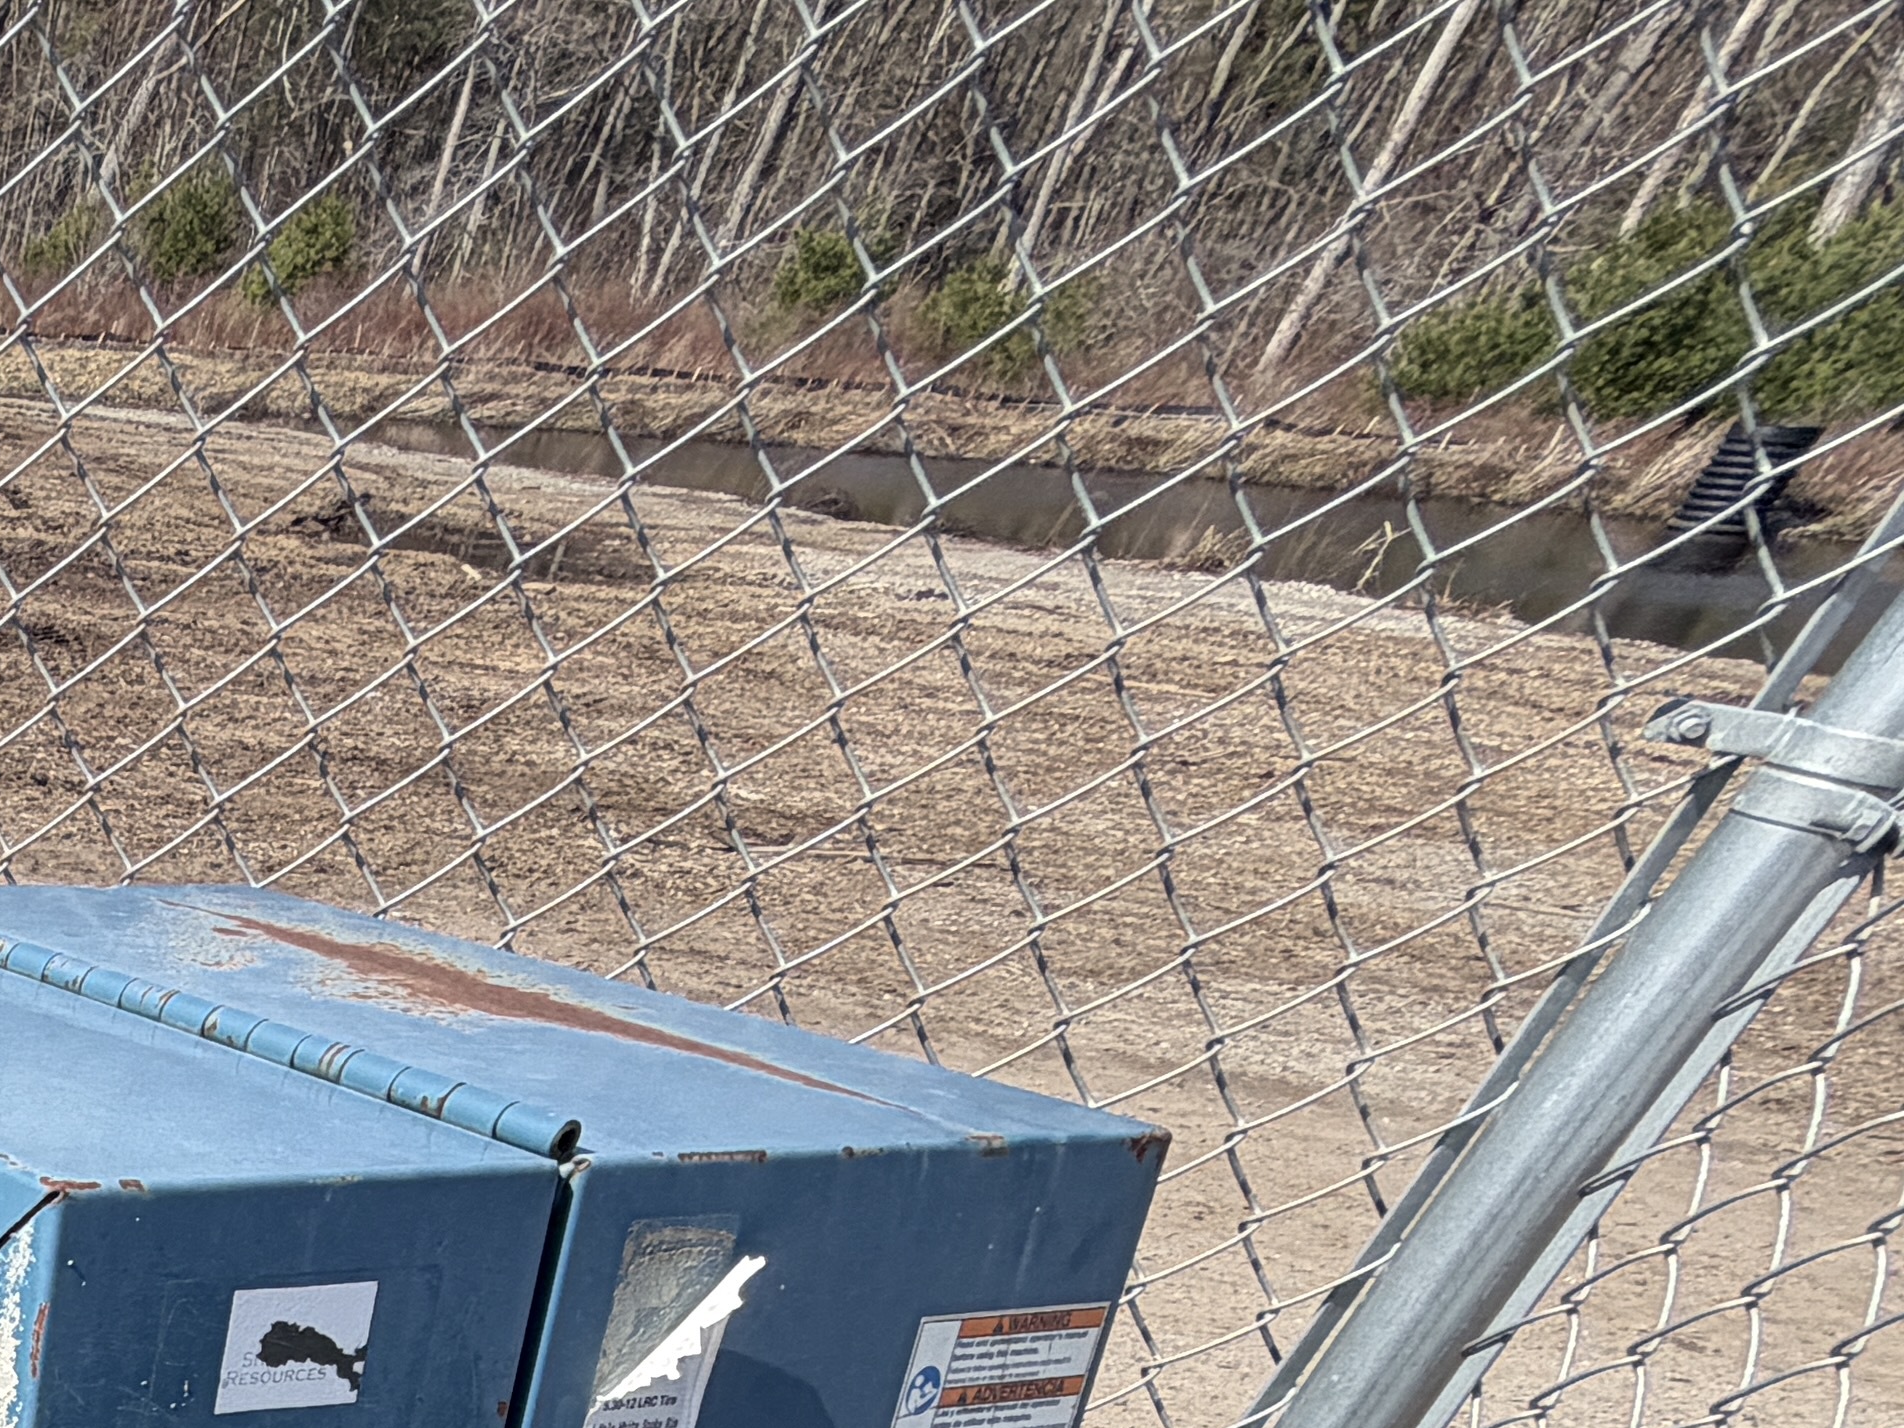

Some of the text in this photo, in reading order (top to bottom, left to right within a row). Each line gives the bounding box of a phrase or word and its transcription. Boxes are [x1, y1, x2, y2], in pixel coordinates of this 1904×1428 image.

[1009, 1312, 1072, 1333] WARNING
[226, 1367, 327, 1387] RESOURCES
[973, 1380, 1065, 1404] ADVERTENCIA
